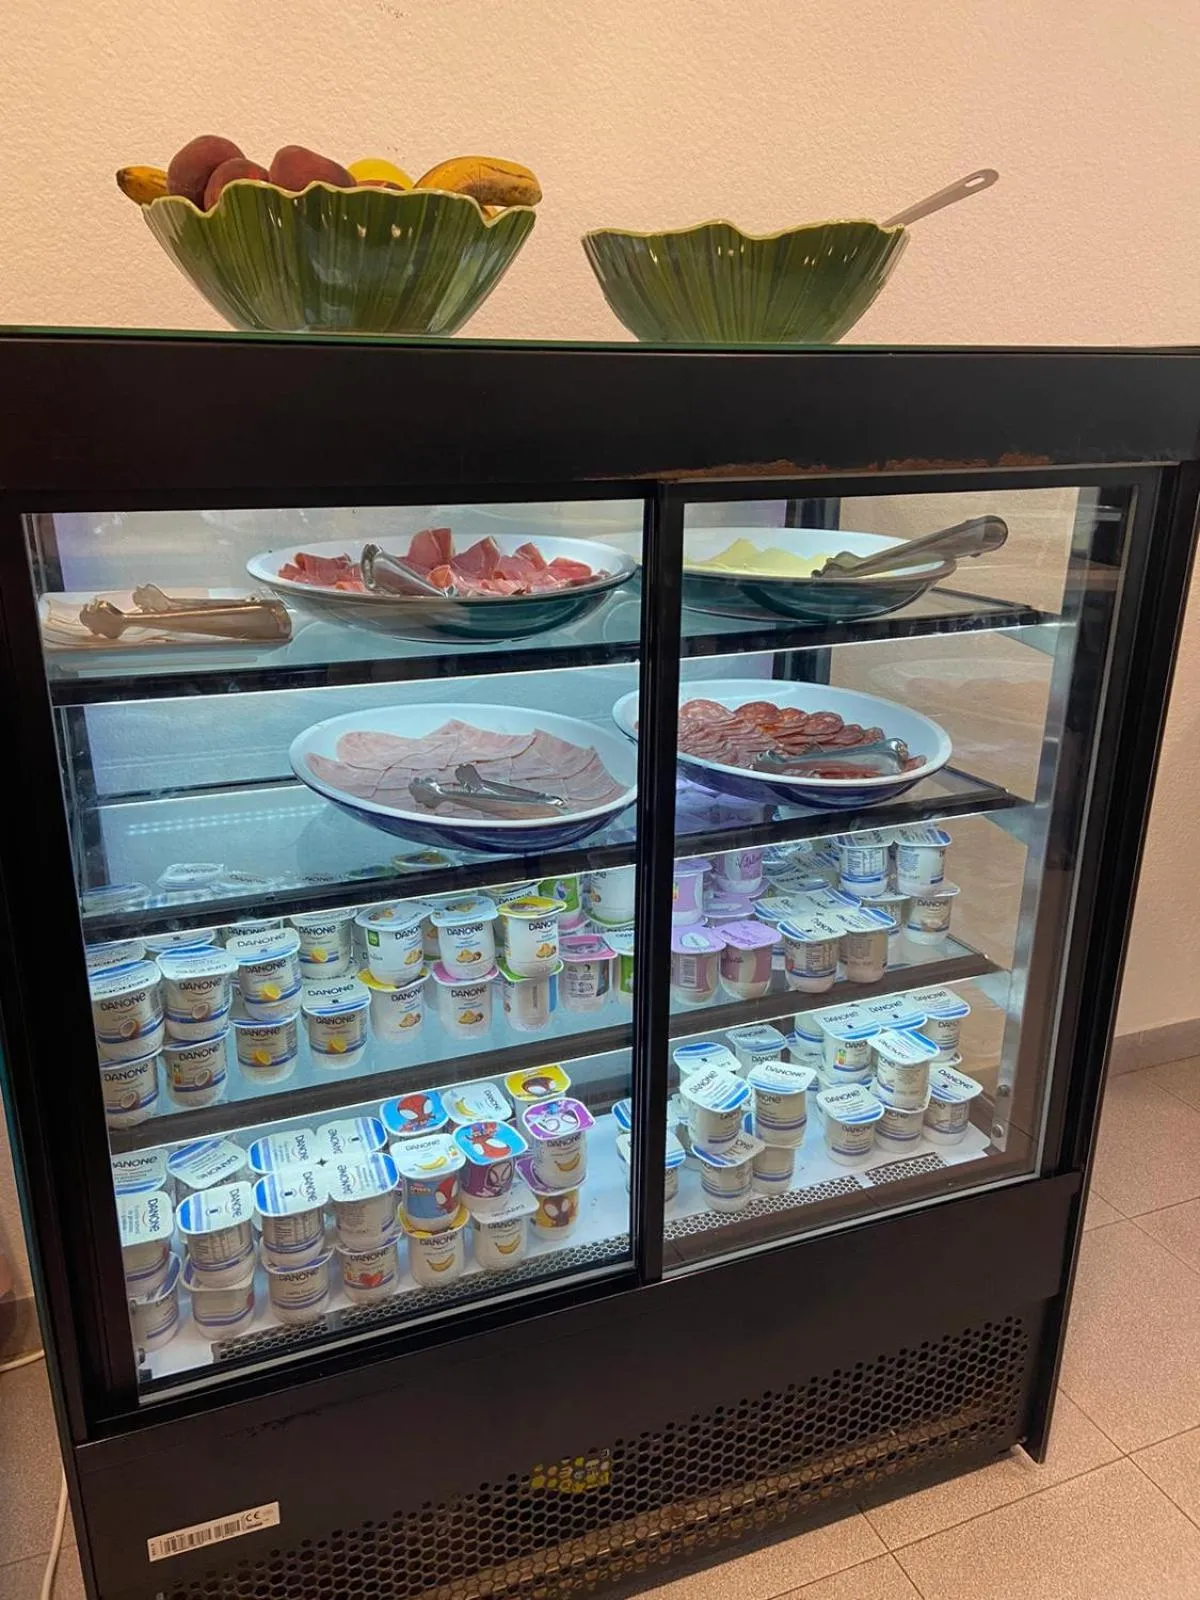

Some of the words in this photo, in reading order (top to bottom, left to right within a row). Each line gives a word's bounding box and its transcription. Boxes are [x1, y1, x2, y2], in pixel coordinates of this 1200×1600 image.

[447, 923, 484, 936] DANONE
[237, 932, 286, 948] DANONE
[245, 959, 287, 973] DANONE
[178, 977, 223, 991] DANONE
[308, 984, 354, 996] DANONE
[451, 986, 487, 998] DANONE
[101, 992, 146, 1011] DANONE
[869, 1001, 903, 1013] DANONE
[315, 1014, 356, 1025] DANONE
[103, 1063, 149, 1082] DANONE
[938, 1069, 974, 1090] DANONE
[295, 1134, 309, 1161] DANONE
[328, 1128, 343, 1155] DANONE
[303, 1171, 318, 1202] DANONE
[337, 1164, 353, 1195] DANONE
[229, 1188, 242, 1219] DANONE
[147, 1197, 160, 1233] DANONE
[420, 1232, 458, 1246] DANONE
[279, 1269, 319, 1282] DANONE
